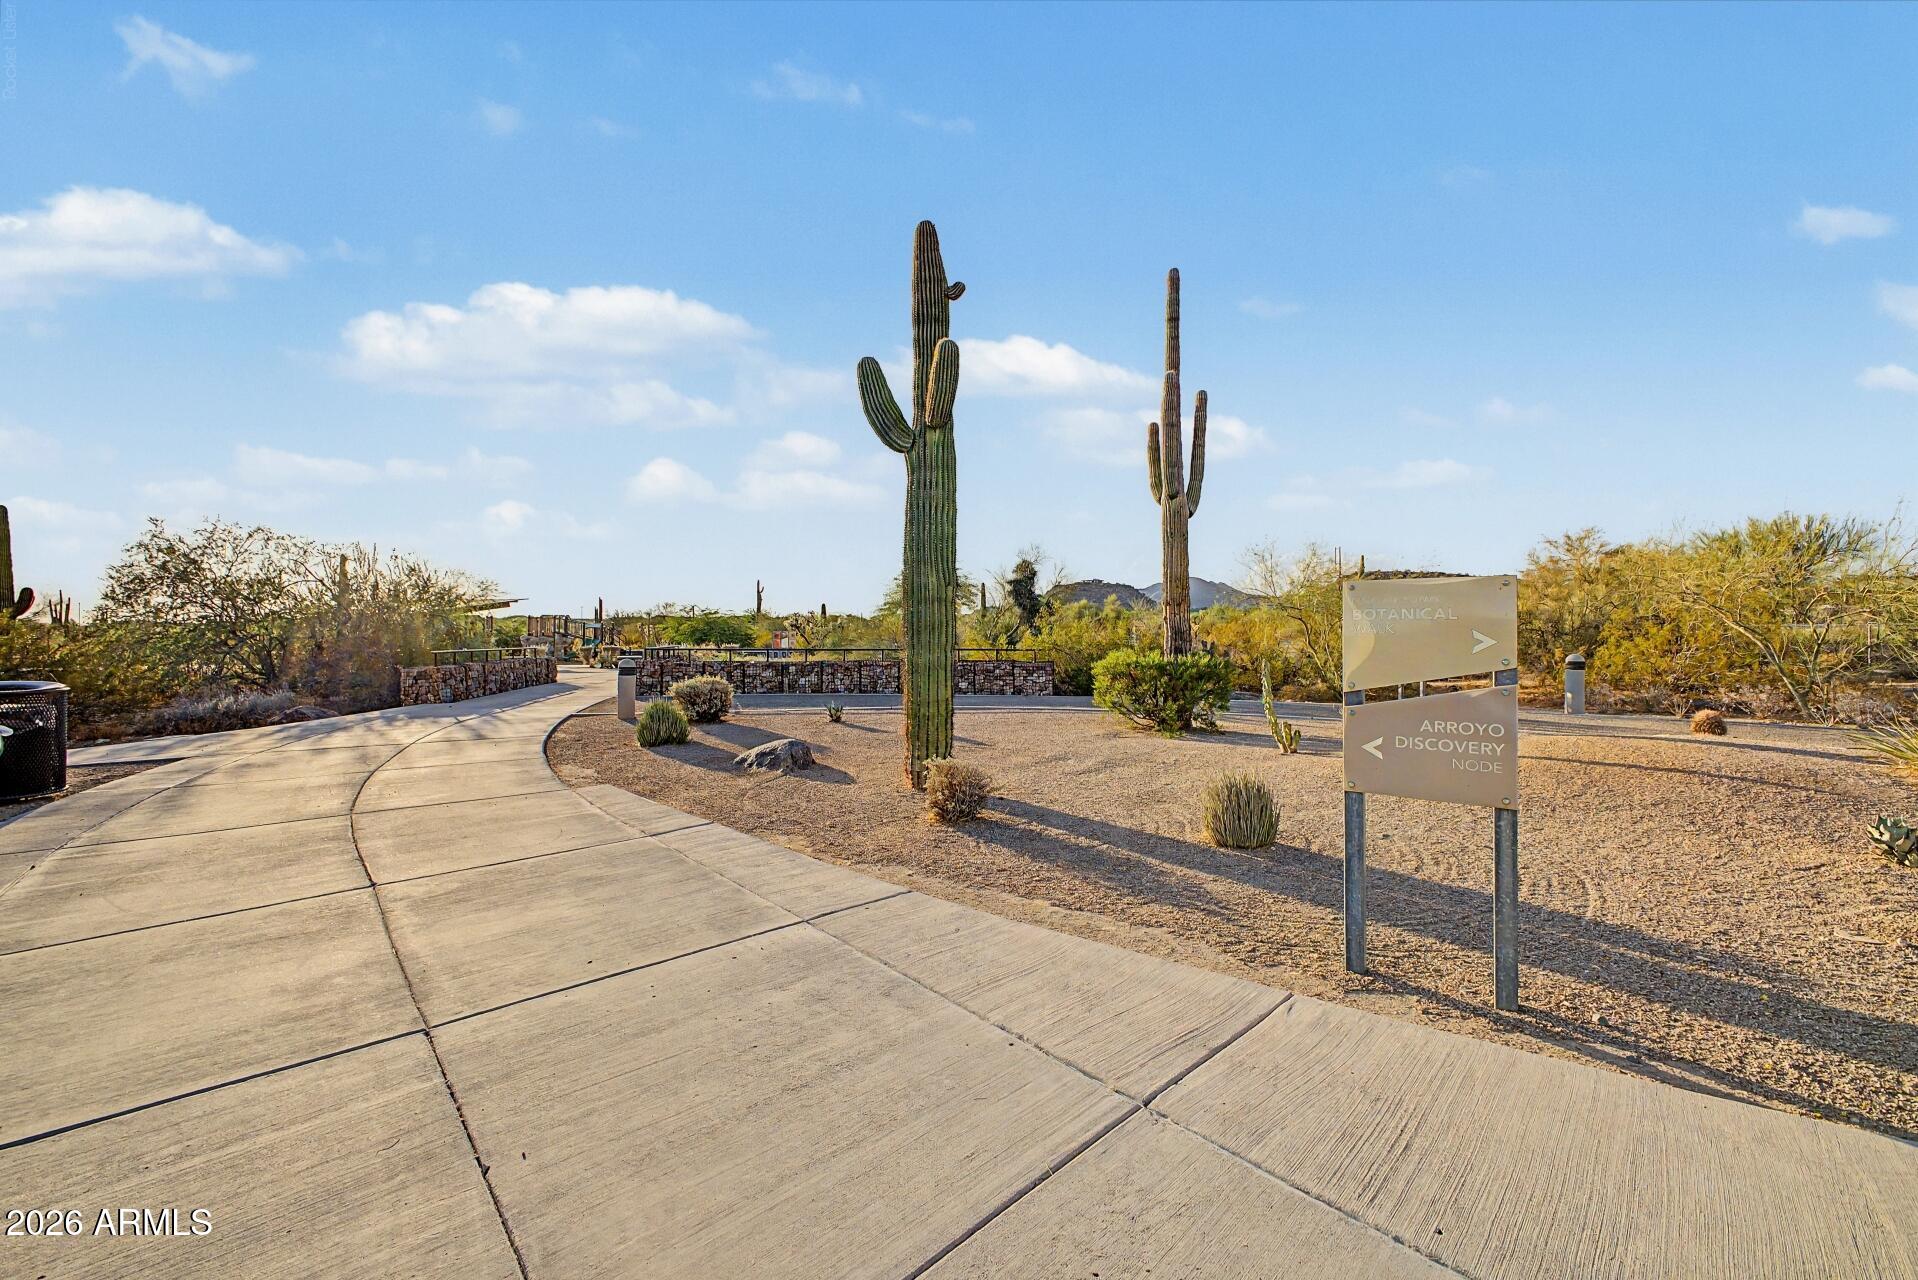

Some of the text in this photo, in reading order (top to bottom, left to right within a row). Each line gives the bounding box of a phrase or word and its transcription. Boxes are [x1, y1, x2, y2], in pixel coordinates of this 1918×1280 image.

[1352, 607, 1458, 621] BOTANICAL
[1420, 719, 1505, 737] ARROYO
[1395, 736, 1505, 757] DISCOVERY
[1452, 758, 1503, 774] NODE
